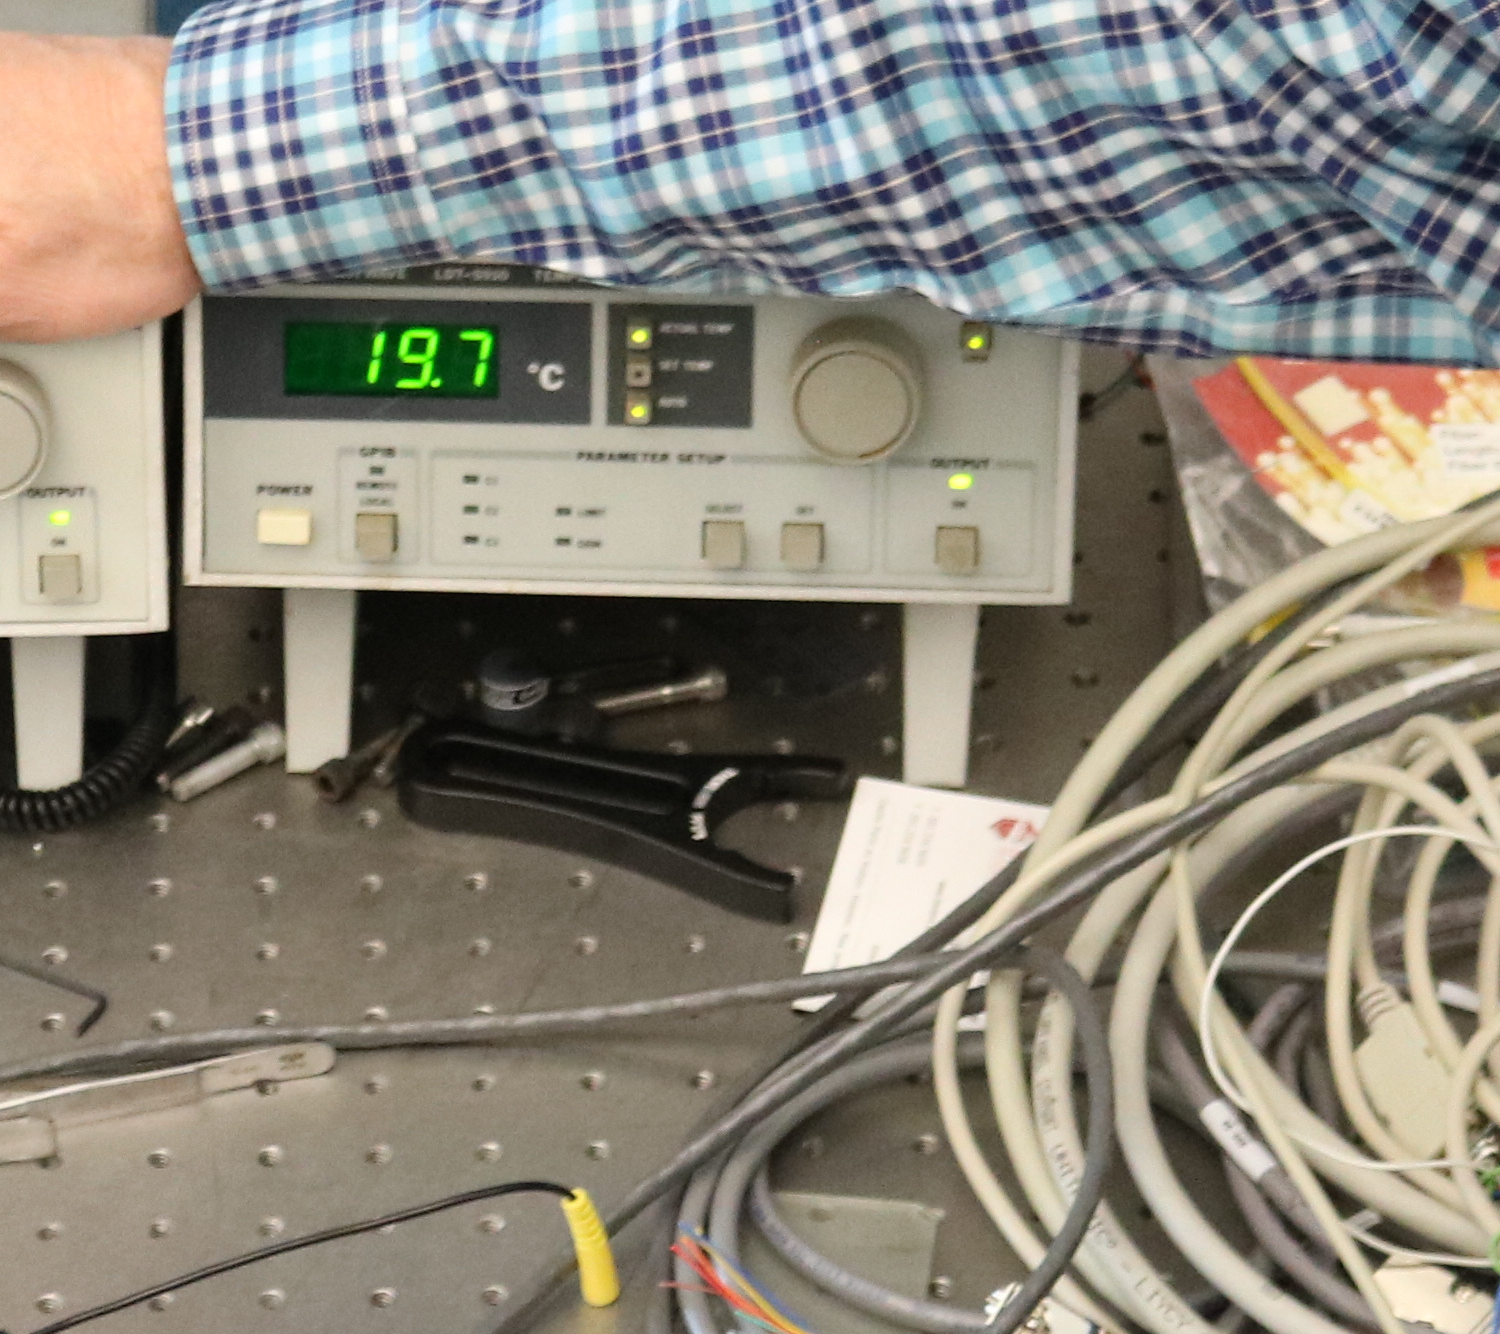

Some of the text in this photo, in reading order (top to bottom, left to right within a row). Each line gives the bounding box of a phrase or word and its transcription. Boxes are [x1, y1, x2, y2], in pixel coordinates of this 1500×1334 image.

[367, 328, 494, 389] 19.7
[576, 451, 726, 464] PARAMETER SETUP
[931, 458, 990, 469] OUTPUT
[25, 486, 86, 498] OUTPUT
[256, 484, 313, 496] POWER
